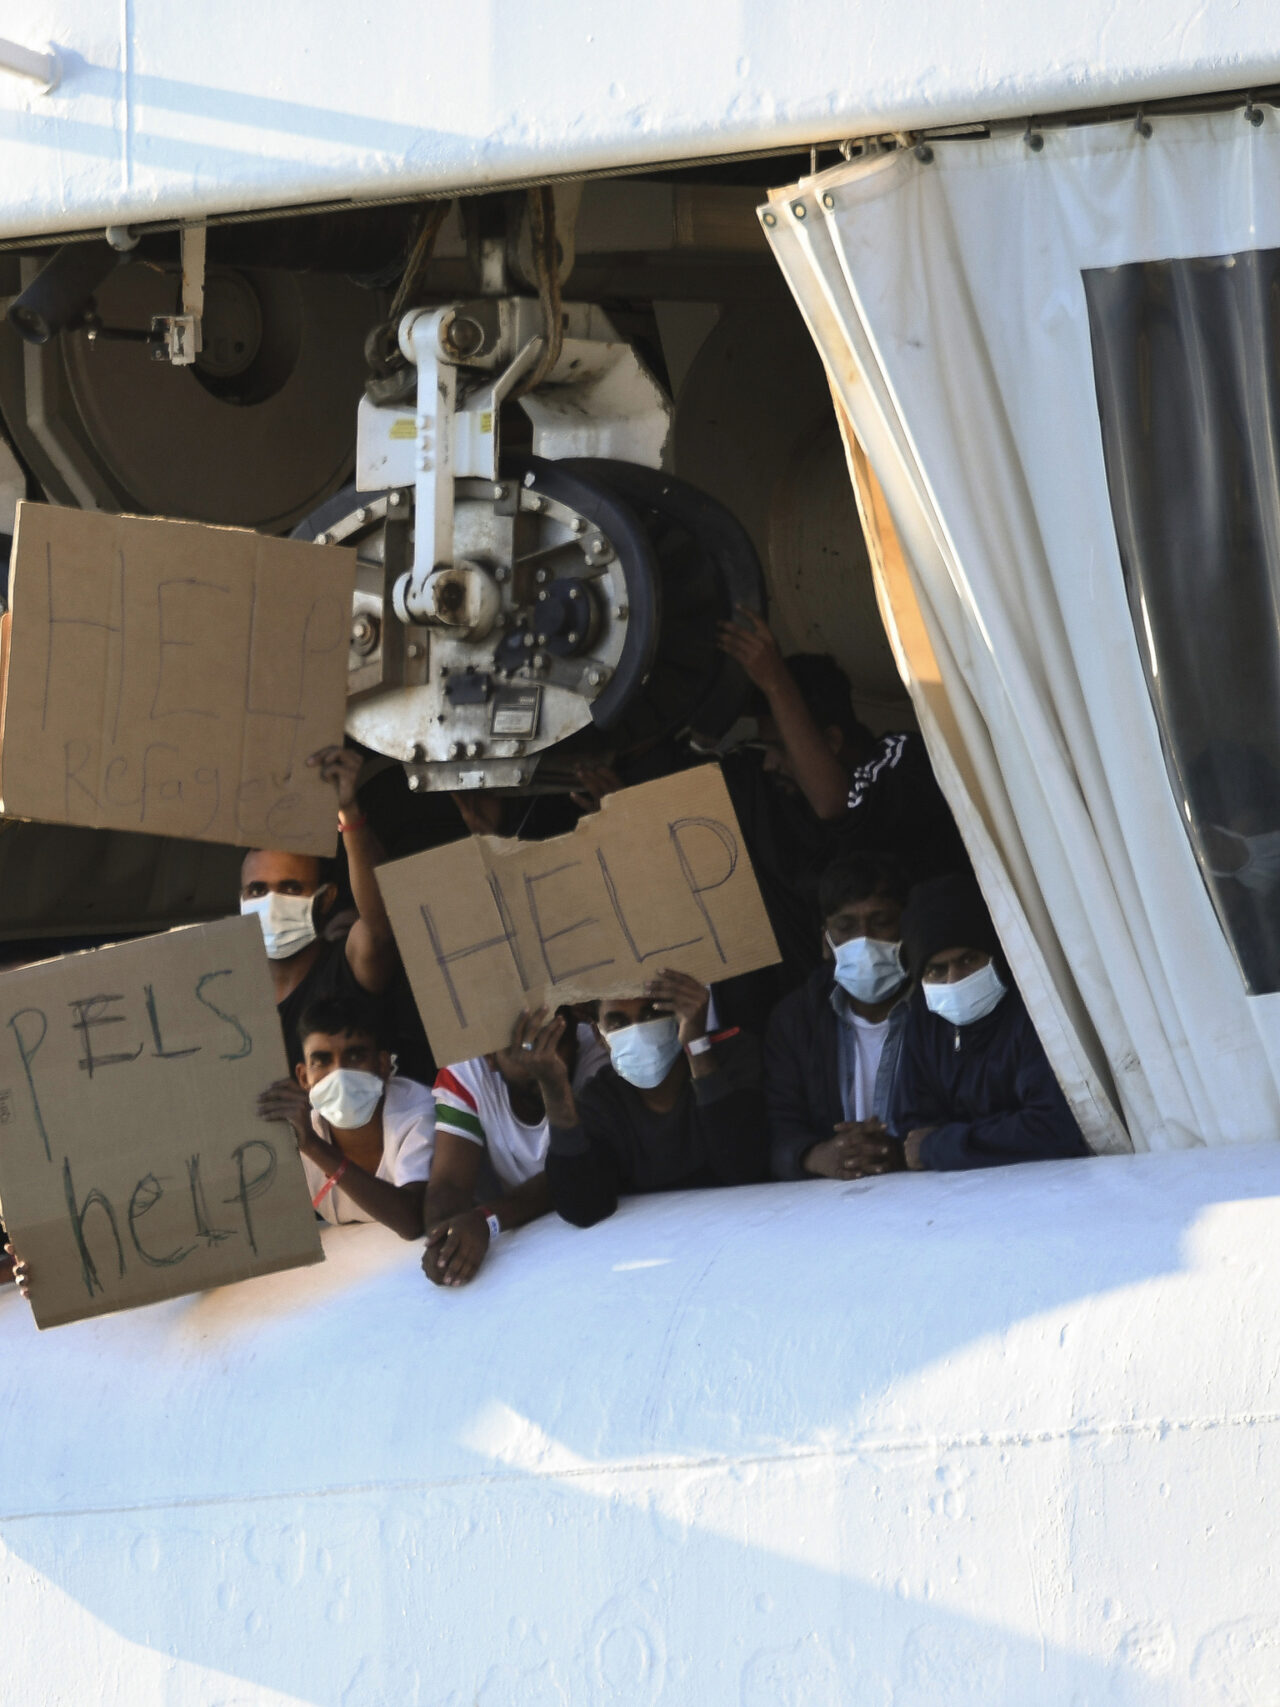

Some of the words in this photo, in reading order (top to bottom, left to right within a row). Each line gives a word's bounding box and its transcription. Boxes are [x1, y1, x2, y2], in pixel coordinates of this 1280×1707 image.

[43, 541, 345, 781] HELP
[419, 816, 739, 1029] HELP
[7, 969, 253, 1163] PELS
